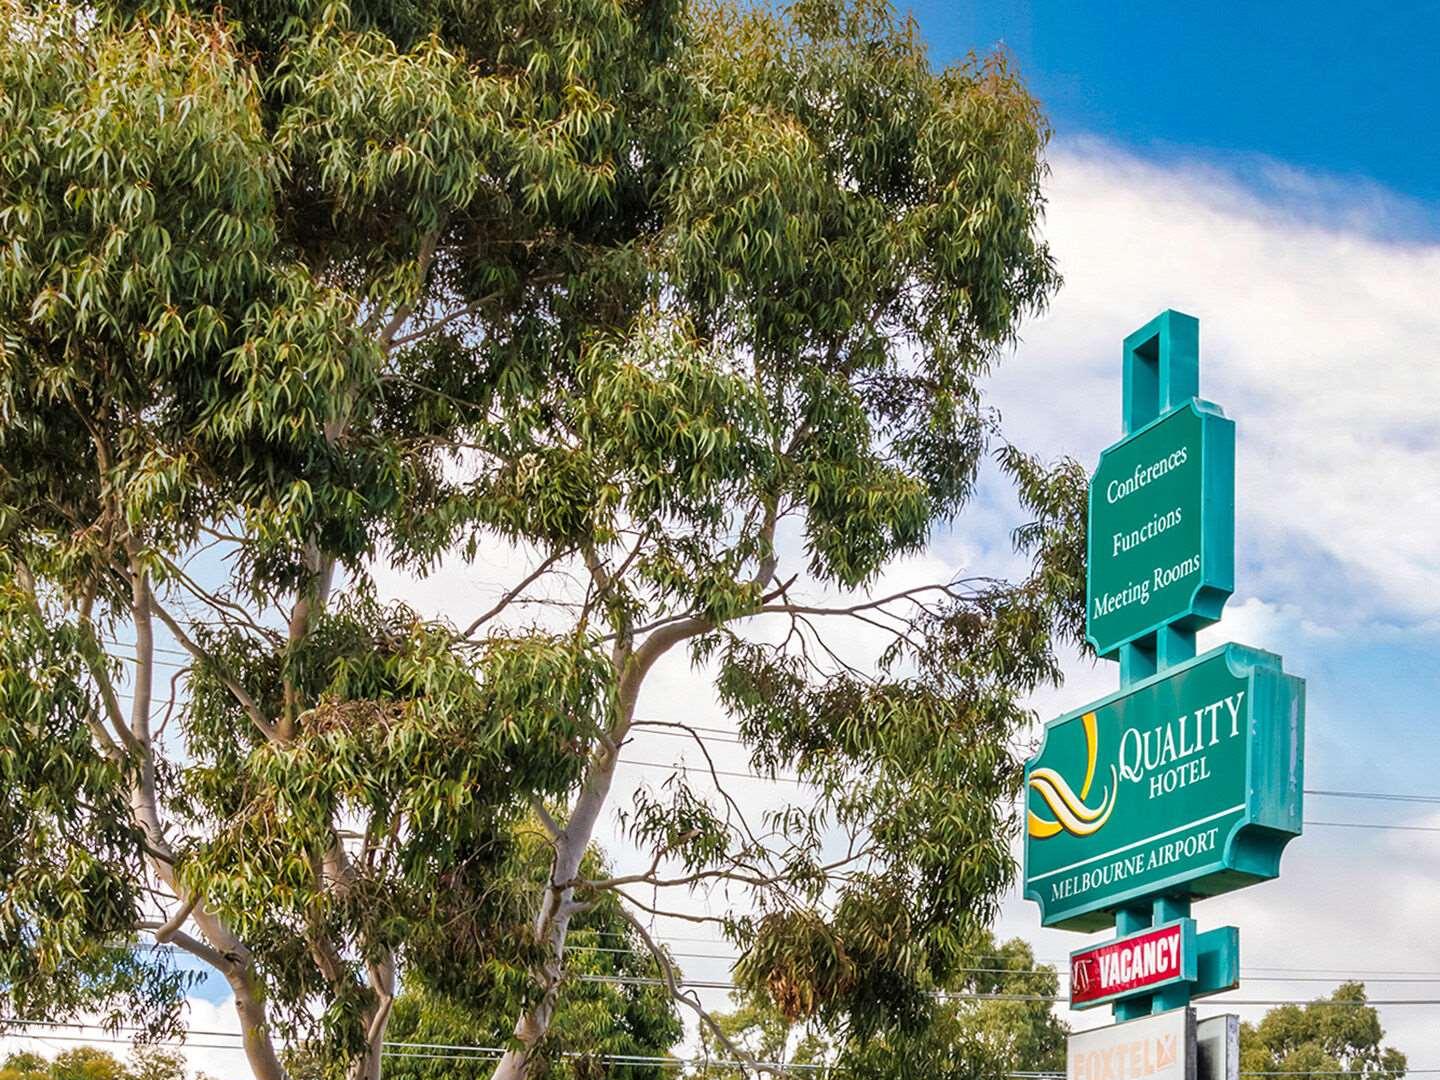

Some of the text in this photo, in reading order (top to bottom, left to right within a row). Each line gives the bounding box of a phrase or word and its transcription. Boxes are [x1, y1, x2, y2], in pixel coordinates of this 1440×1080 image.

[1107, 446, 1187, 504] Conferences
[1112, 507, 1182, 557] Functions
[1093, 554, 1199, 619] Meeting Rooms
[1119, 691, 1245, 783] QUALITY
[1149, 757, 1211, 799] HOTEL
[1051, 827, 1218, 901] MELBOURNE AIRPORT
[1099, 933, 1180, 989] VACANCY
